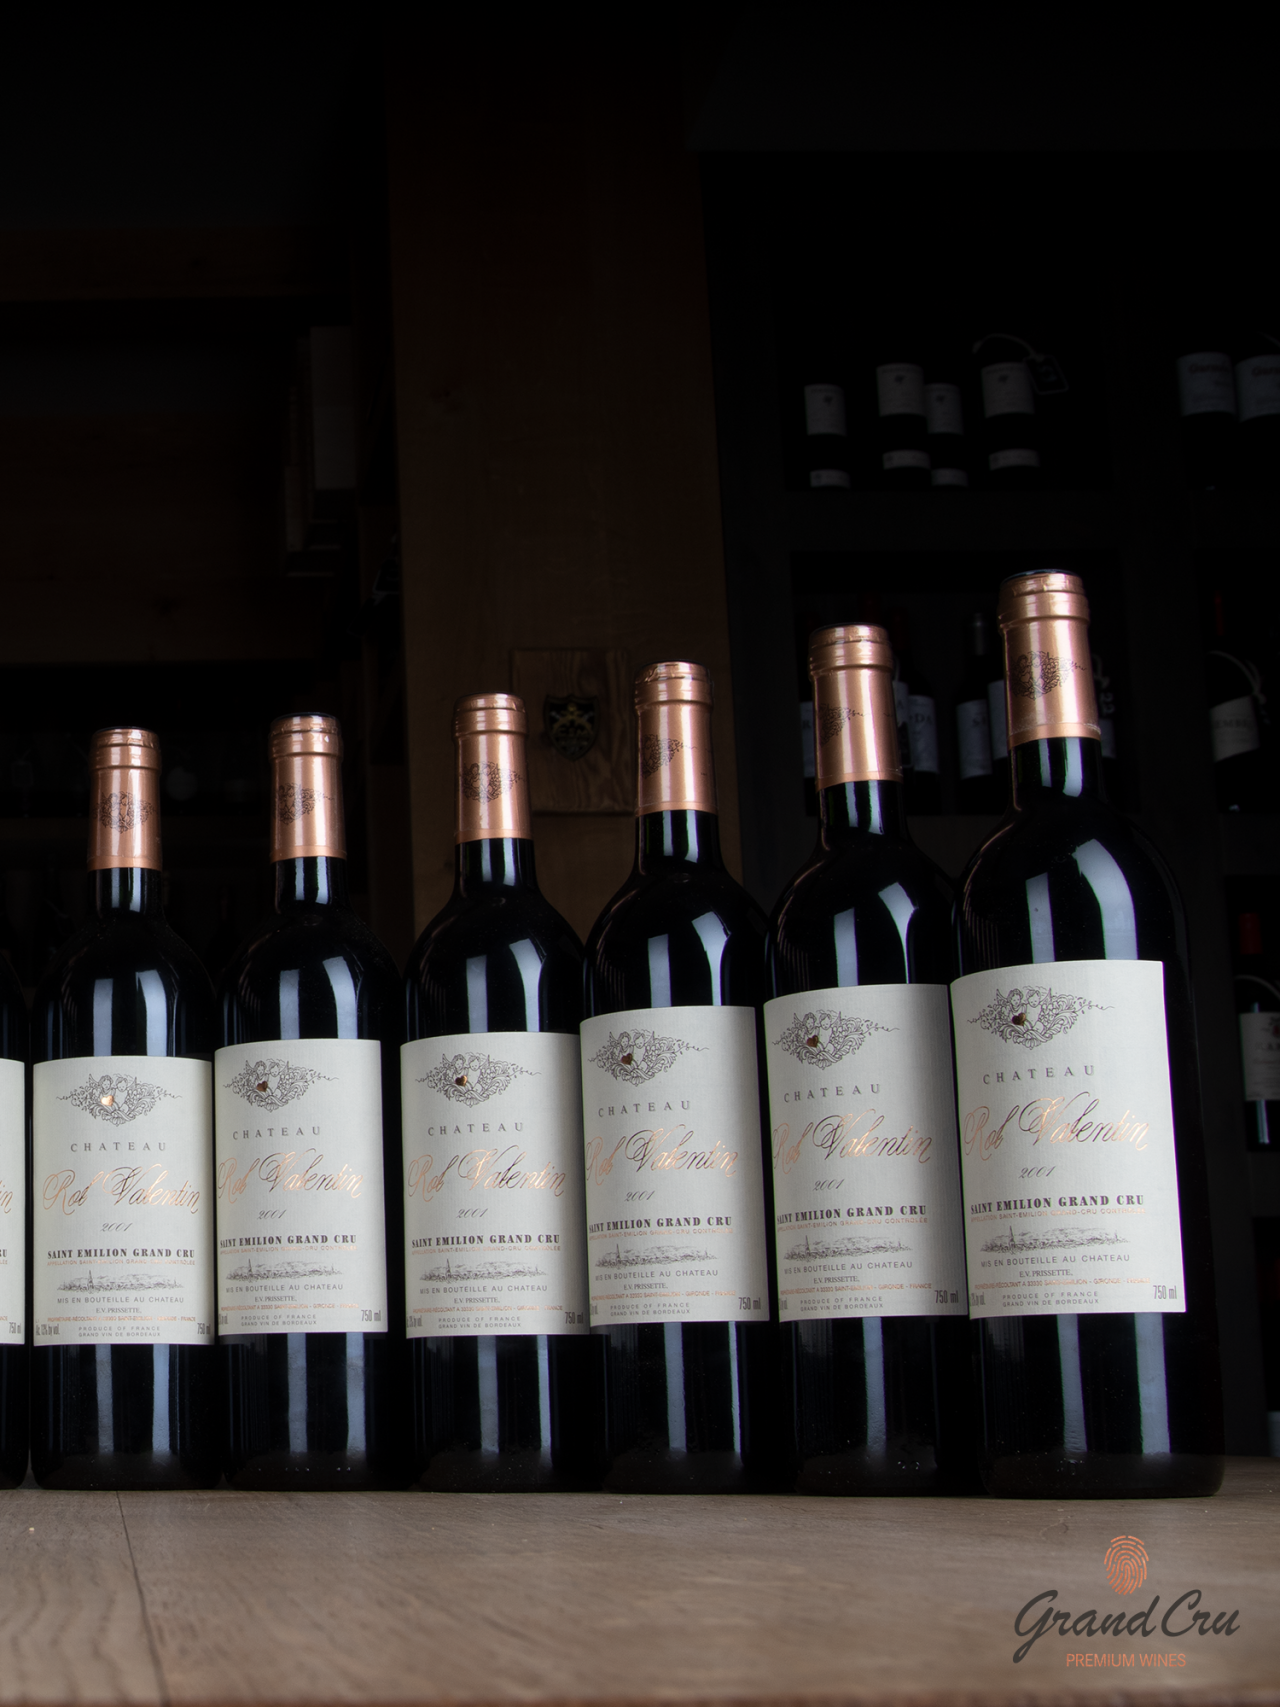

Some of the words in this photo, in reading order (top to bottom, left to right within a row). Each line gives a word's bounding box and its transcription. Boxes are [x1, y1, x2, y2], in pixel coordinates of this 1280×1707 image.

[983, 1065, 1094, 1085] CHATEAU
[784, 1084, 880, 1103] CHATEAU
[598, 1101, 690, 1117] CHATEAU
[1018, 1091, 1150, 1151] Valentin
[233, 1126, 320, 1140] CHATEAU
[427, 1123, 523, 1136] CHATEAU
[812, 1108, 932, 1164] Valentin
[71, 1142, 166, 1152] CHATEAU
[624, 1124, 738, 1178] Valentin
[258, 1148, 364, 1199] Valentin
[457, 1145, 566, 1197] Valentin
[1018, 1166, 1056, 1179] 2001
[102, 1163, 200, 1214] Valentin
[812, 1179, 845, 1191] 2001
[624, 1190, 655, 1202] 2001
[970, 1202, 992, 1215] SAINT
[996, 1197, 1051, 1211] EMILION
[1058, 1195, 1110, 1207] GRAND
[1116, 1194, 1144, 1205] CRU
[257, 1210, 287, 1220] 2001
[455, 1208, 489, 1218] 2001
[795, 1209, 841, 1222] EMILION
[847, 1206, 893, 1218] GRAND
[900, 1205, 927, 1216] CRU
[100, 1223, 133, 1232] 2001
[607, 1219, 651, 1231] EMILION
[656, 1217, 701, 1228] GRAND
[706, 1216, 732, 1226] CRU
[220, 1239, 236, 1249] SAINT
[239, 1236, 282, 1247] EMILION
[287, 1235, 328, 1244] GRAND
[334, 1234, 357, 1244] CRU
[412, 1238, 432, 1249] SAINT
[436, 1235, 484, 1246] EMILION
[489, 1235, 532, 1244] GRAND
[537, 1234, 560, 1243] CRU
[47, 1250, 73, 1259] SAINT
[77, 1249, 127, 1258] EMILION
[132, 1248, 172, 1257] GRAND
[176, 1249, 195, 1258] CRU
[994, 1259, 1003, 1267] EN
[1007, 1256, 1058, 1266] BOUTEILLE
[1062, 1255, 1076, 1264] AU
[1081, 1254, 1130, 1263] CHATEAU
[934, 1290, 948, 1304] 750
[949, 1290, 959, 1303] ml
[1152, 1285, 1167, 1300] 750
[1168, 1285, 1177, 1299] ml
[738, 1297, 751, 1310] 750
[753, 1297, 761, 1310] ml
